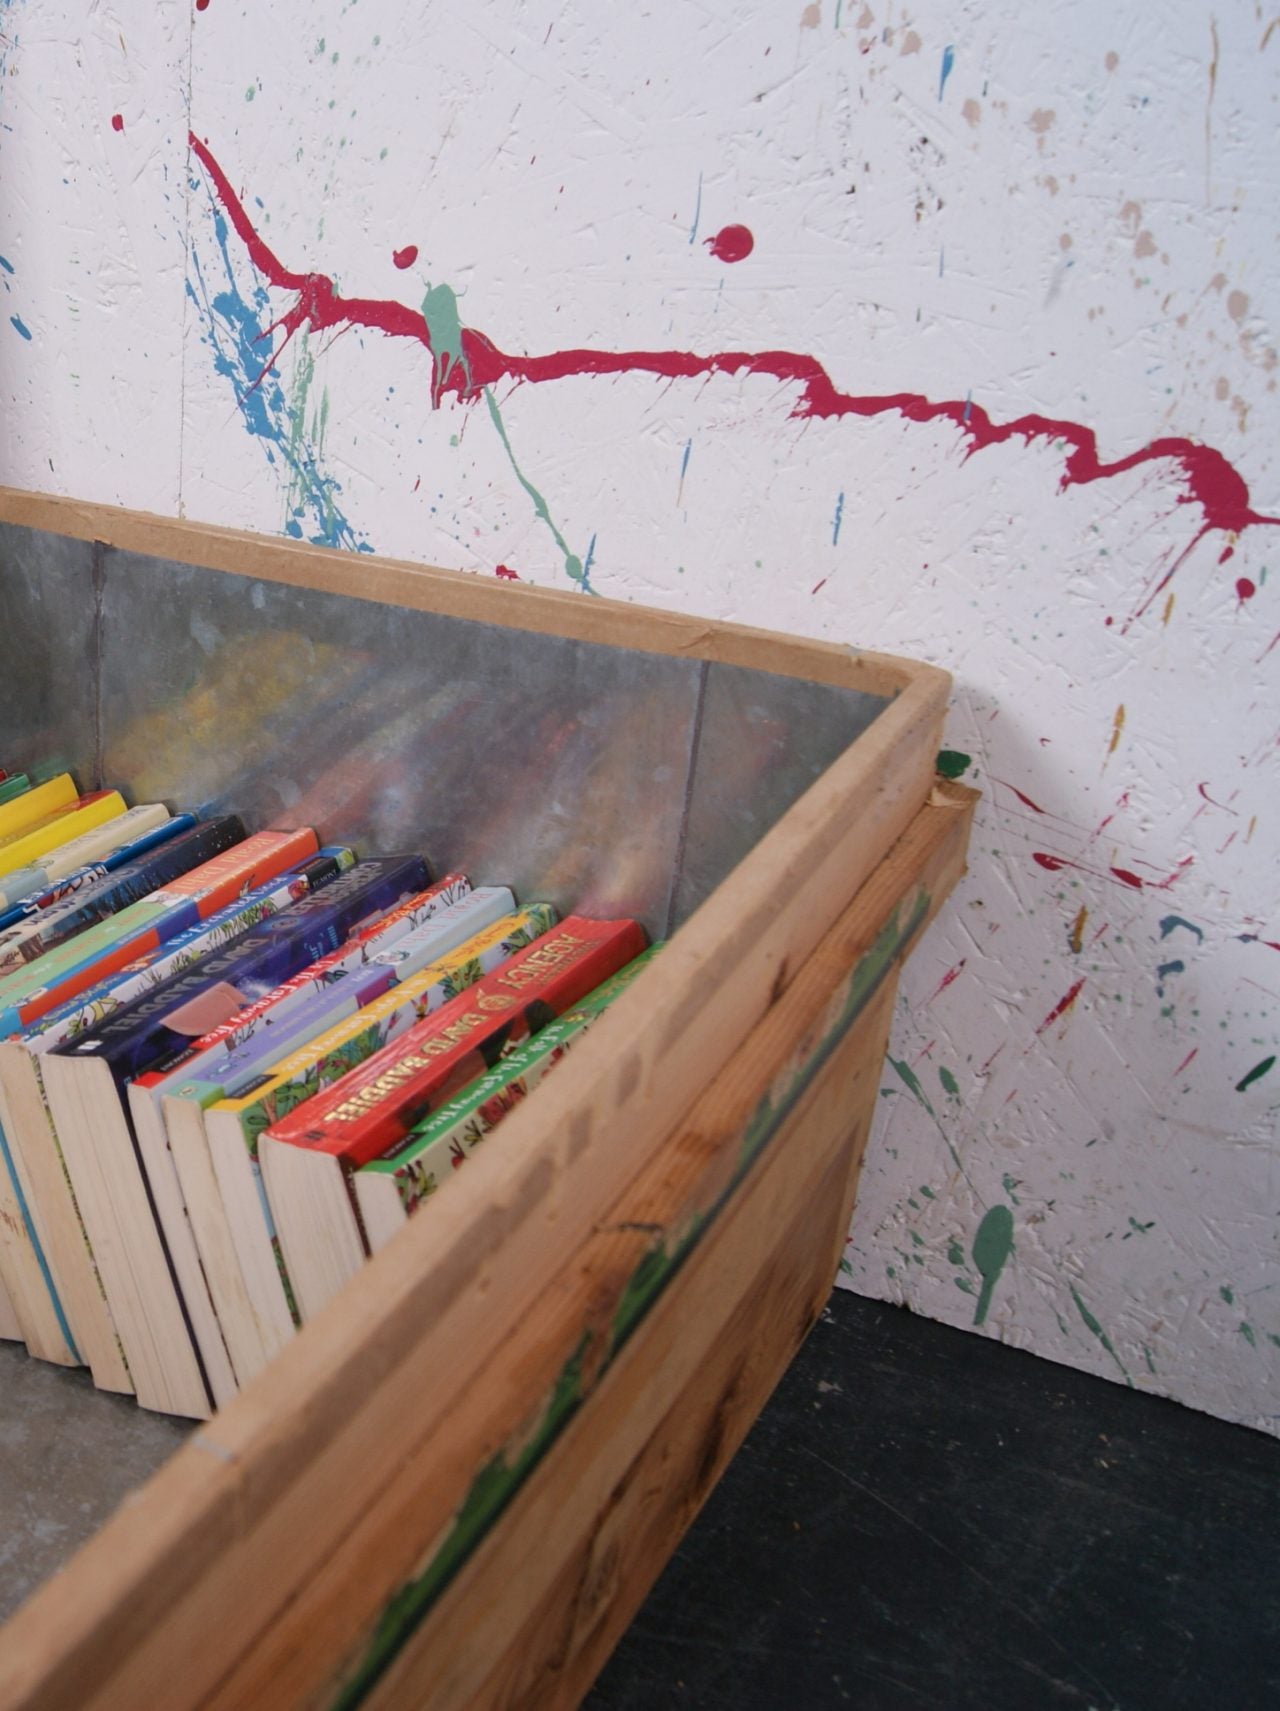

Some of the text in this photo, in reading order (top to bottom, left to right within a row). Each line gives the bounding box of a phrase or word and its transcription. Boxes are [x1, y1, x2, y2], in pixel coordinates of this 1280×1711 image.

[228, 837, 276, 863] Roald
[175, 866, 223, 893] Dahl
[279, 861, 382, 917] CONTROLLER
[166, 931, 194, 948] The
[196, 891, 256, 934] Enchanted
[202, 937, 271, 975] DAVID
[313, 957, 335, 972] Up
[497, 932, 585, 990] AGENCY
[101, 972, 209, 1033] BADDIEL
[230, 984, 299, 1023] Faraway
[199, 1024, 238, 1044] Tree
[323, 1012, 488, 1123] DAVID BADDIEL
[449, 1074, 504, 1110] Faraway
[422, 1111, 458, 1132] Tree
